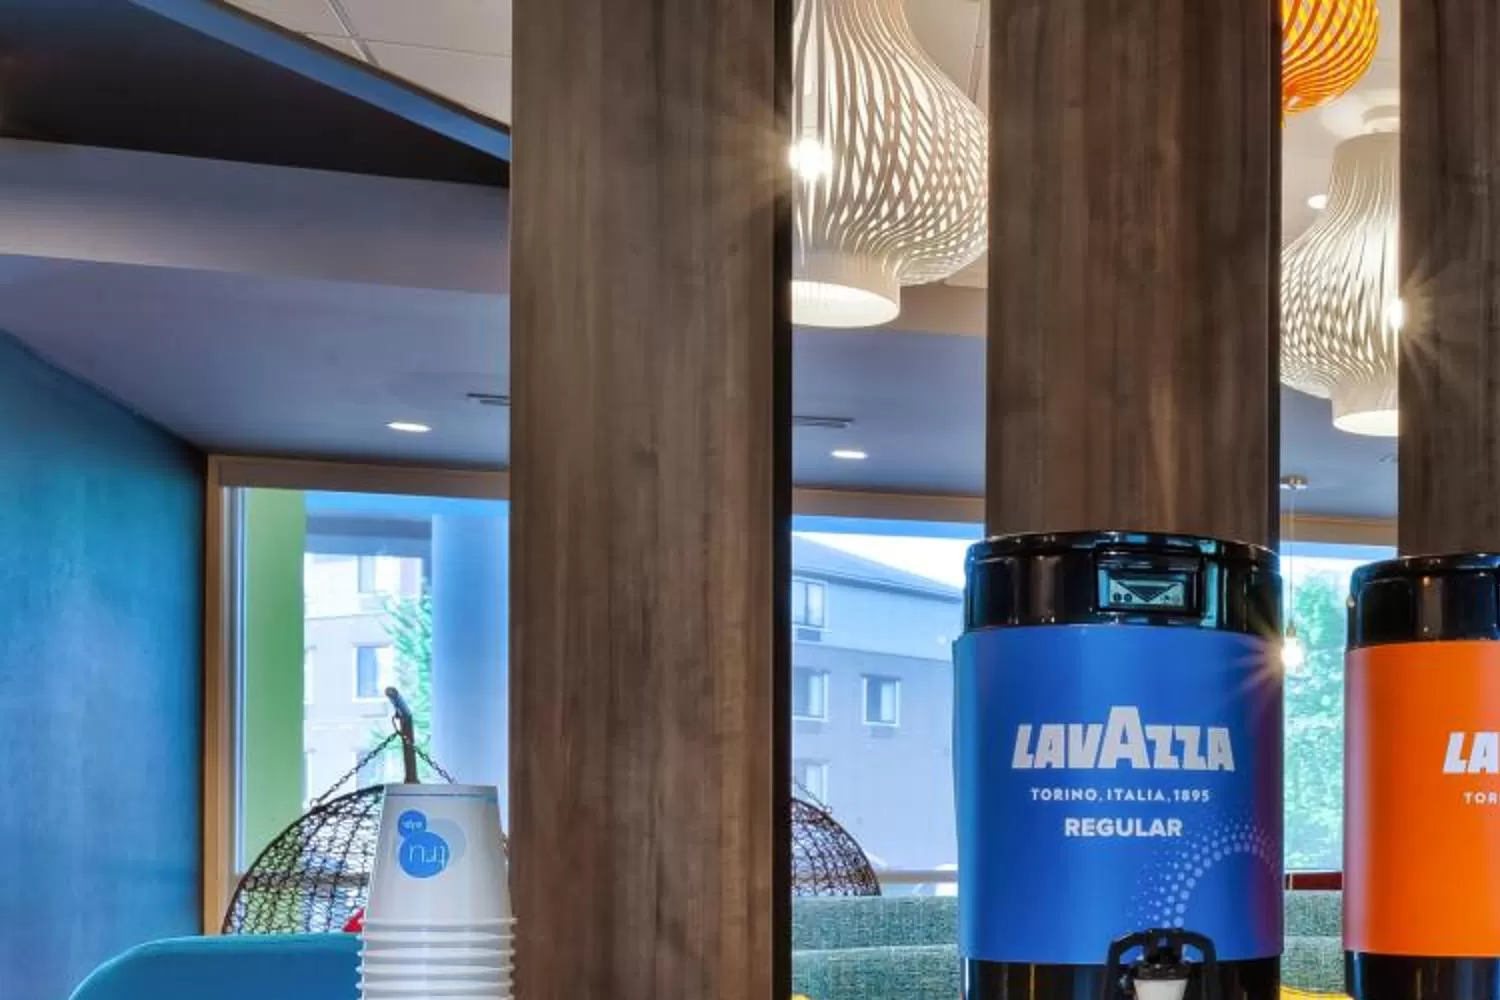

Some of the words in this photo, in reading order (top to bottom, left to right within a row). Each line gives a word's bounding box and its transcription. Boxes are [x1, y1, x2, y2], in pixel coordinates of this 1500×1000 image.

[1012, 705, 1235, 772] LAVAZZA
[1173, 788, 1210, 802] 1895
[1064, 817, 1184, 837] REGULAR
